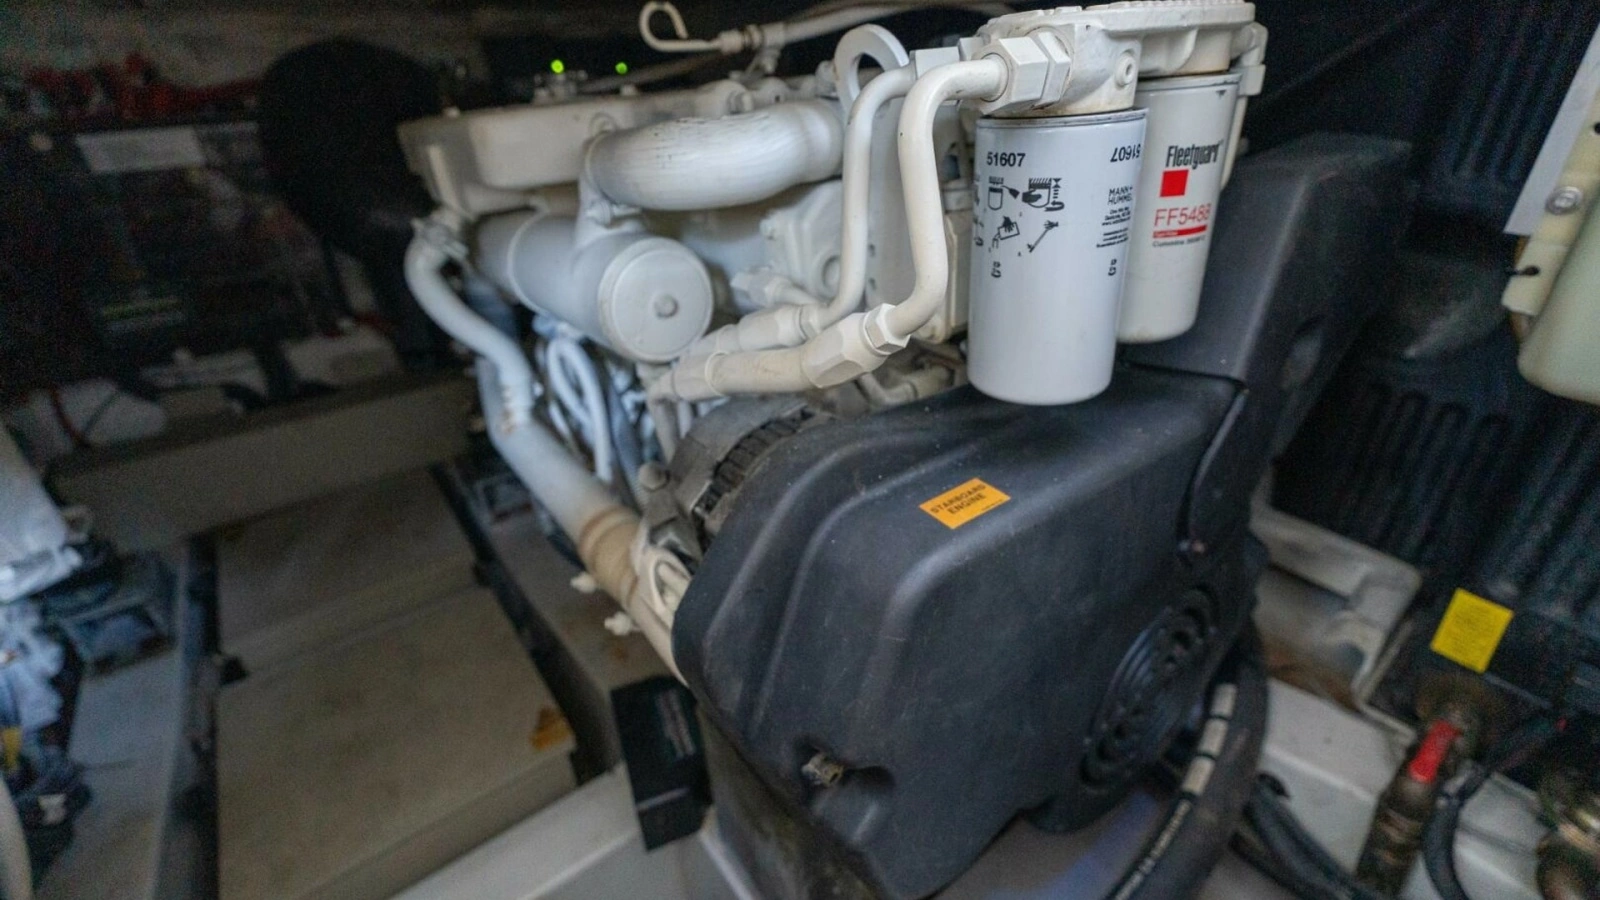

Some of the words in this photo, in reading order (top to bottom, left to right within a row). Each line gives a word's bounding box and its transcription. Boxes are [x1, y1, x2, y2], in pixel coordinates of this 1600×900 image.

[986, 151, 1026, 167] 51607
[929, 483, 987, 514] STARBOARD
[947, 492, 987, 515] ENGINE
